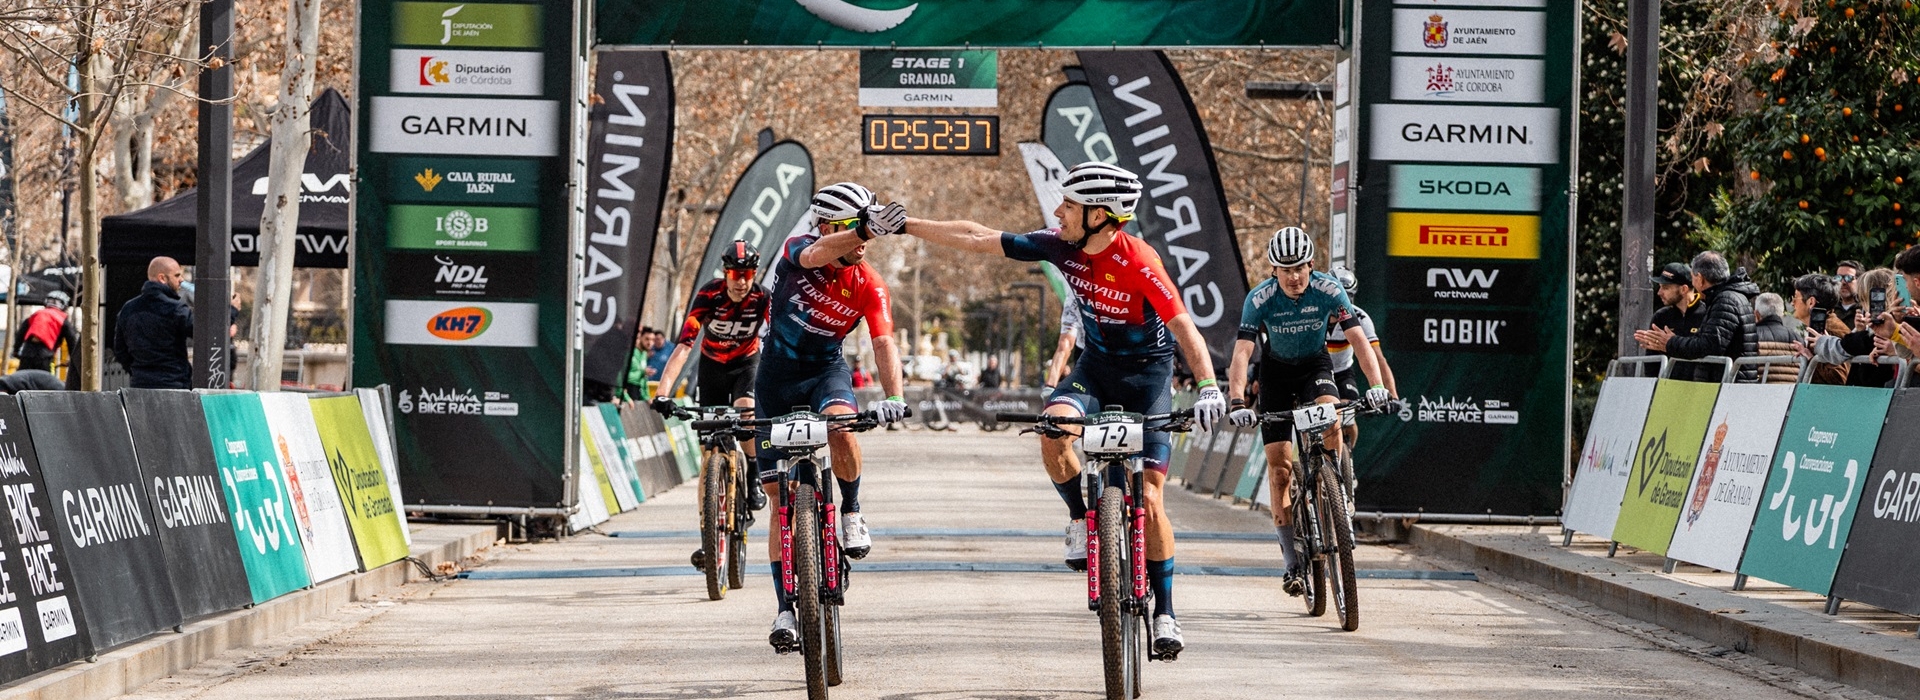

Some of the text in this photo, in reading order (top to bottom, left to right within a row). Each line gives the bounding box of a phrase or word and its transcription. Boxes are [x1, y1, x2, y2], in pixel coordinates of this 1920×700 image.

[1454, 27, 1515, 36] AYUNTAMIENTO
[1465, 36, 1487, 44] JAÉN
[455, 64, 512, 77] Diputación
[891, 57, 965, 70] STAGE 1
[455, 75, 512, 85] de Córdoba
[899, 73, 956, 86] GRANADA
[1455, 69, 1515, 80] AYUNTAMIENTO
[1455, 81, 1465, 91] DE
[903, 93, 954, 103] GARMIN
[401, 115, 527, 137] GARMIN
[870, 120, 991, 150] 02:52:37
[1401, 122, 1527, 145] GARMIN
[447, 172, 515, 184] CAJA RURAL
[466, 182, 494, 193] JAÉN
[817, 210, 836, 219] GIST
[1419, 225, 1509, 247] PIRELLI
[434, 265, 489, 283] NDL
[1062, 270, 1131, 303] TORPADO
[1150, 277, 1174, 301] KENDA
[1310, 277, 1342, 298] KTM
[1434, 290, 1489, 300] northwave
[796, 275, 859, 318] TORPADO
[1086, 298, 1130, 314] KENDA
[806, 307, 848, 327] KENDA
[1300, 305, 1319, 314] KTM
[707, 319, 758, 336] BH
[1423, 318, 1500, 345] GOBIK
[418, 387, 481, 402] Andalucía
[1418, 395, 1481, 411] Andalucía
[419, 402, 482, 415] BIKE RACE
[1304, 406, 1327, 425] 1-2
[1418, 410, 1482, 423] BIKE RACE
[786, 422, 811, 441] 7-1
[1099, 425, 1128, 448] 7-2
[154, 475, 223, 528] GARMIN
[3, 483, 50, 545] BIKE
[62, 483, 147, 548] GARMIN
[781, 526, 793, 585] MANITOU
[825, 522, 836, 582] MANITOU
[1088, 530, 1098, 592] MANITOU
[1134, 528, 1144, 590] MANITOU
[21, 543, 65, 596] RACE
[42, 606, 70, 631] GARMIN
